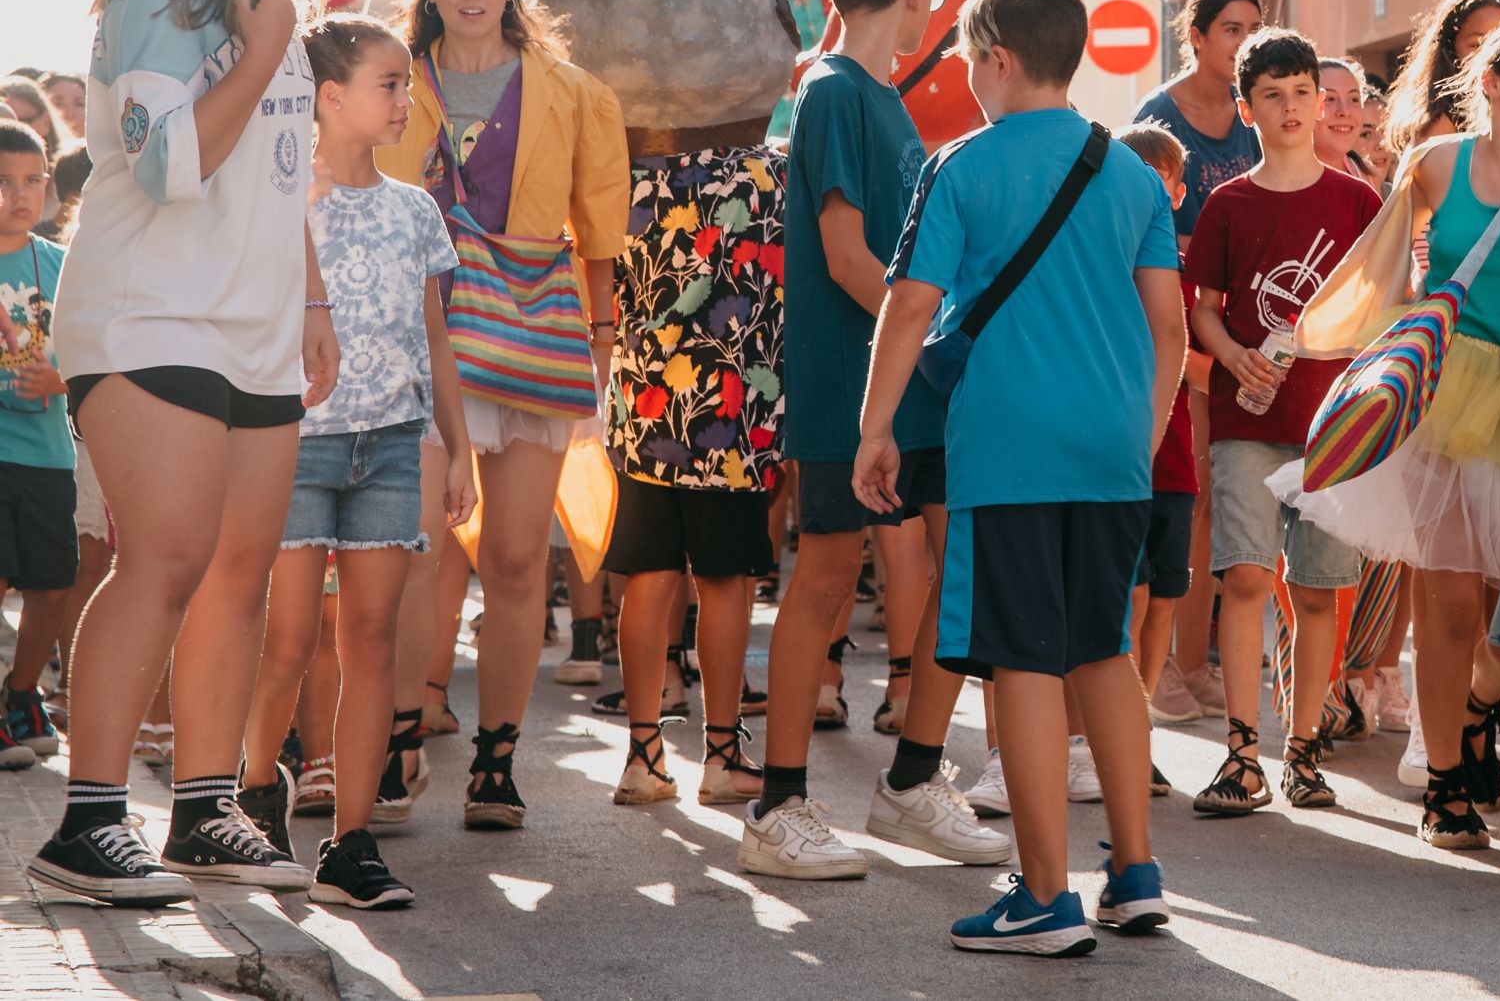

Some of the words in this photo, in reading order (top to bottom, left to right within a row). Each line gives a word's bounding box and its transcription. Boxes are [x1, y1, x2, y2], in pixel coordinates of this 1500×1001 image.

[261, 98, 276, 117] NEW
[279, 97, 295, 115] YORK
[296, 95, 312, 114] CITY
